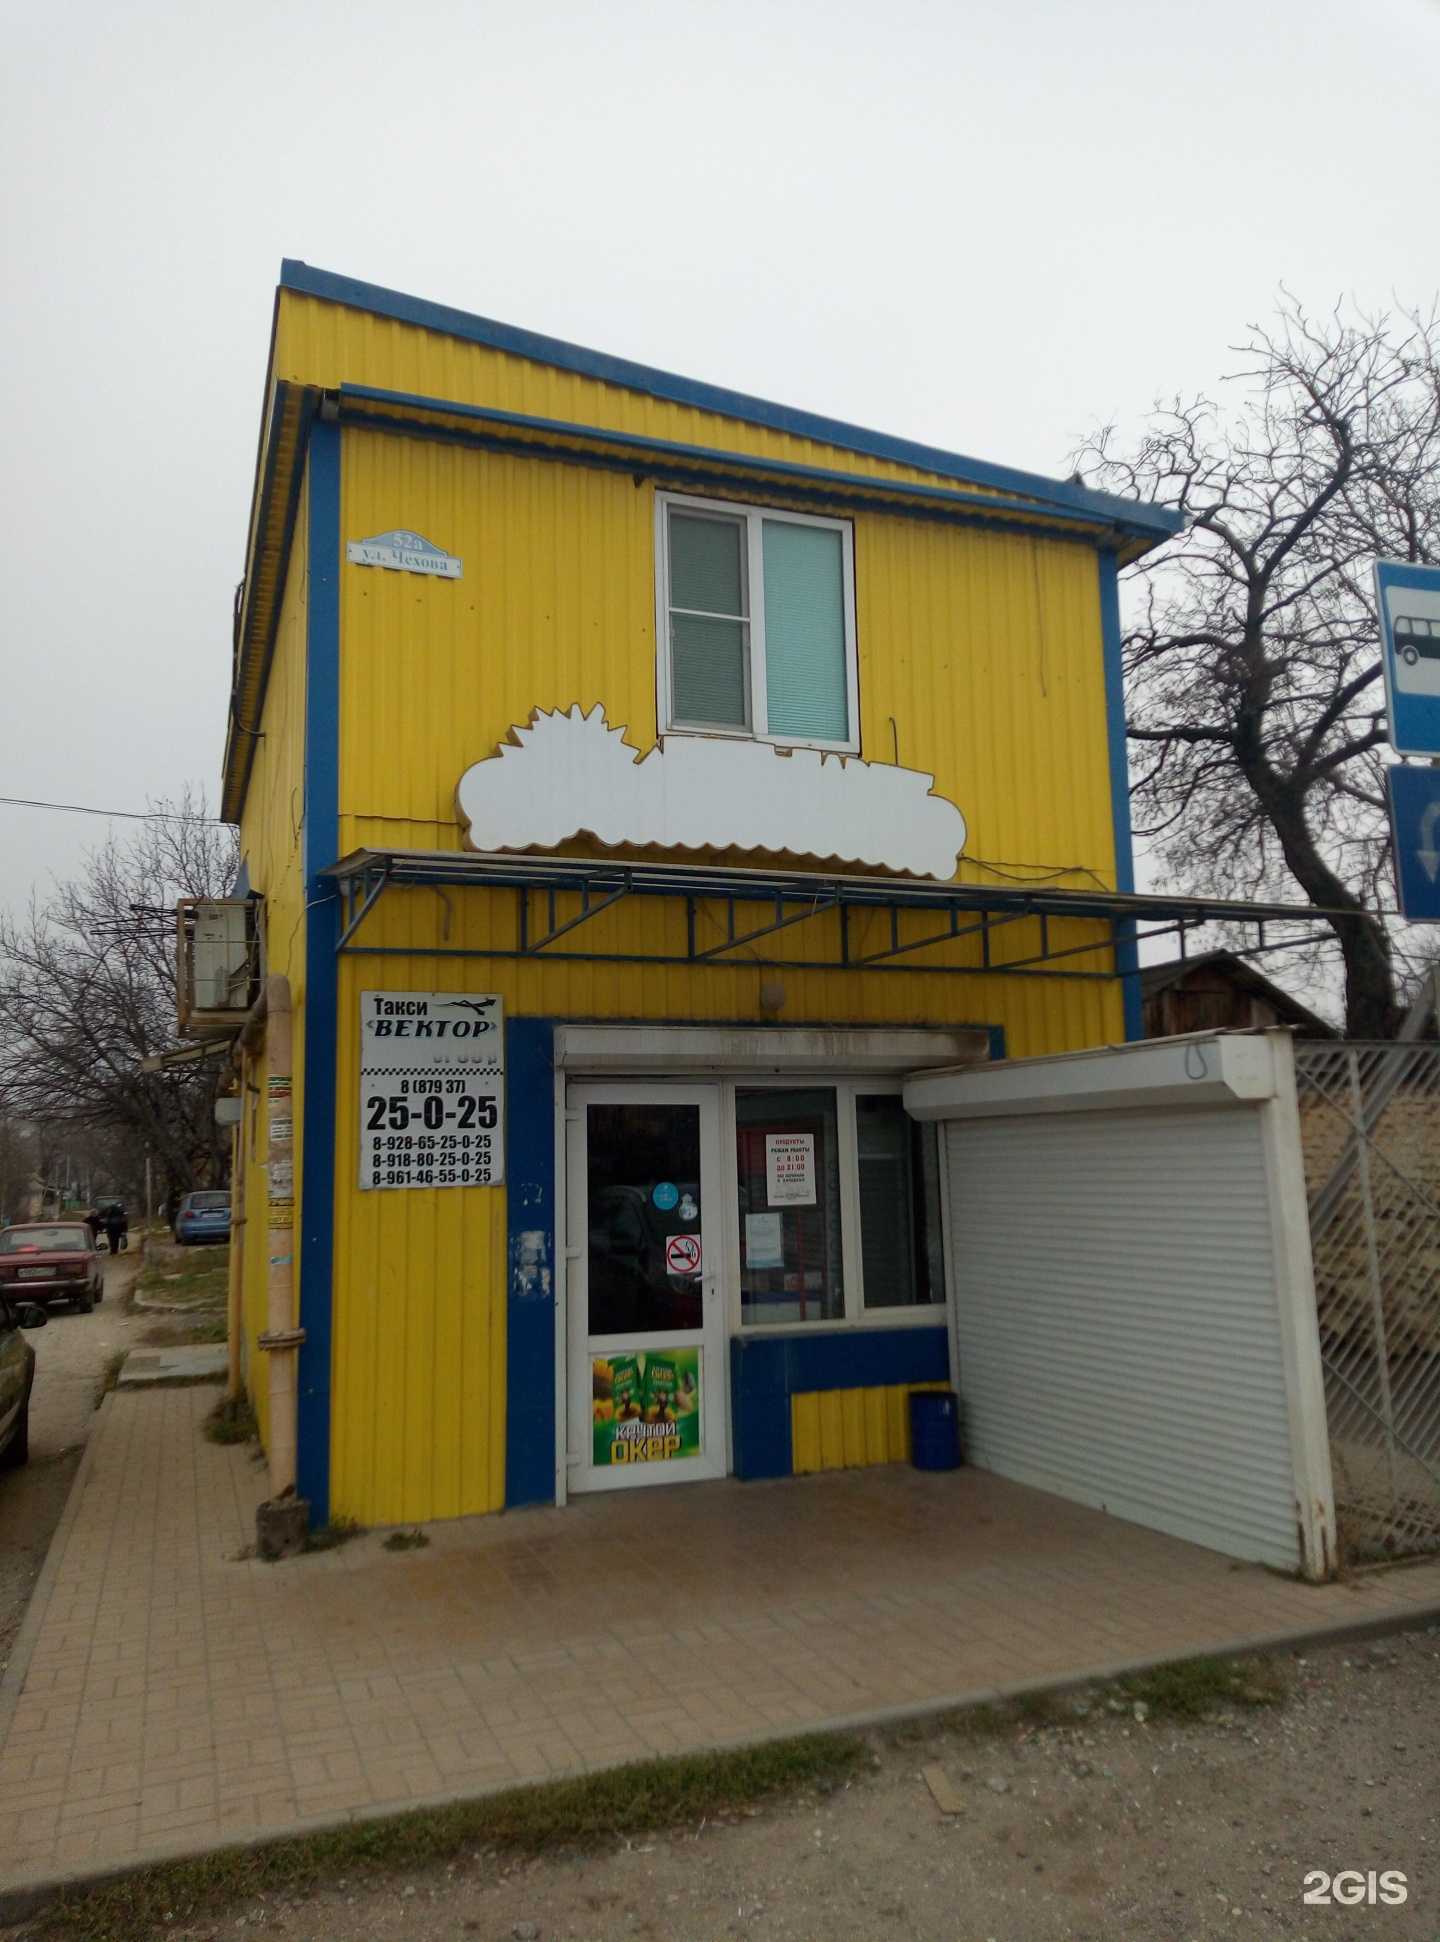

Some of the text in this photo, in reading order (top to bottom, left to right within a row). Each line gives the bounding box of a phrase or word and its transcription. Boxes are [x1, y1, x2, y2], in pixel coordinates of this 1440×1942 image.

[391, 550, 448, 571] Чехова
[373, 998, 428, 1016] Такси
[400, 1079, 410, 1094] 8
[367, 1095, 498, 1131] 25-0-25
[372, 1135, 492, 1151] 8-928-65-25-0-25
[372, 1151, 492, 1168] 8-918-80-25-0-25
[372, 1168, 492, 1185] 8-961-46-55-0-25
